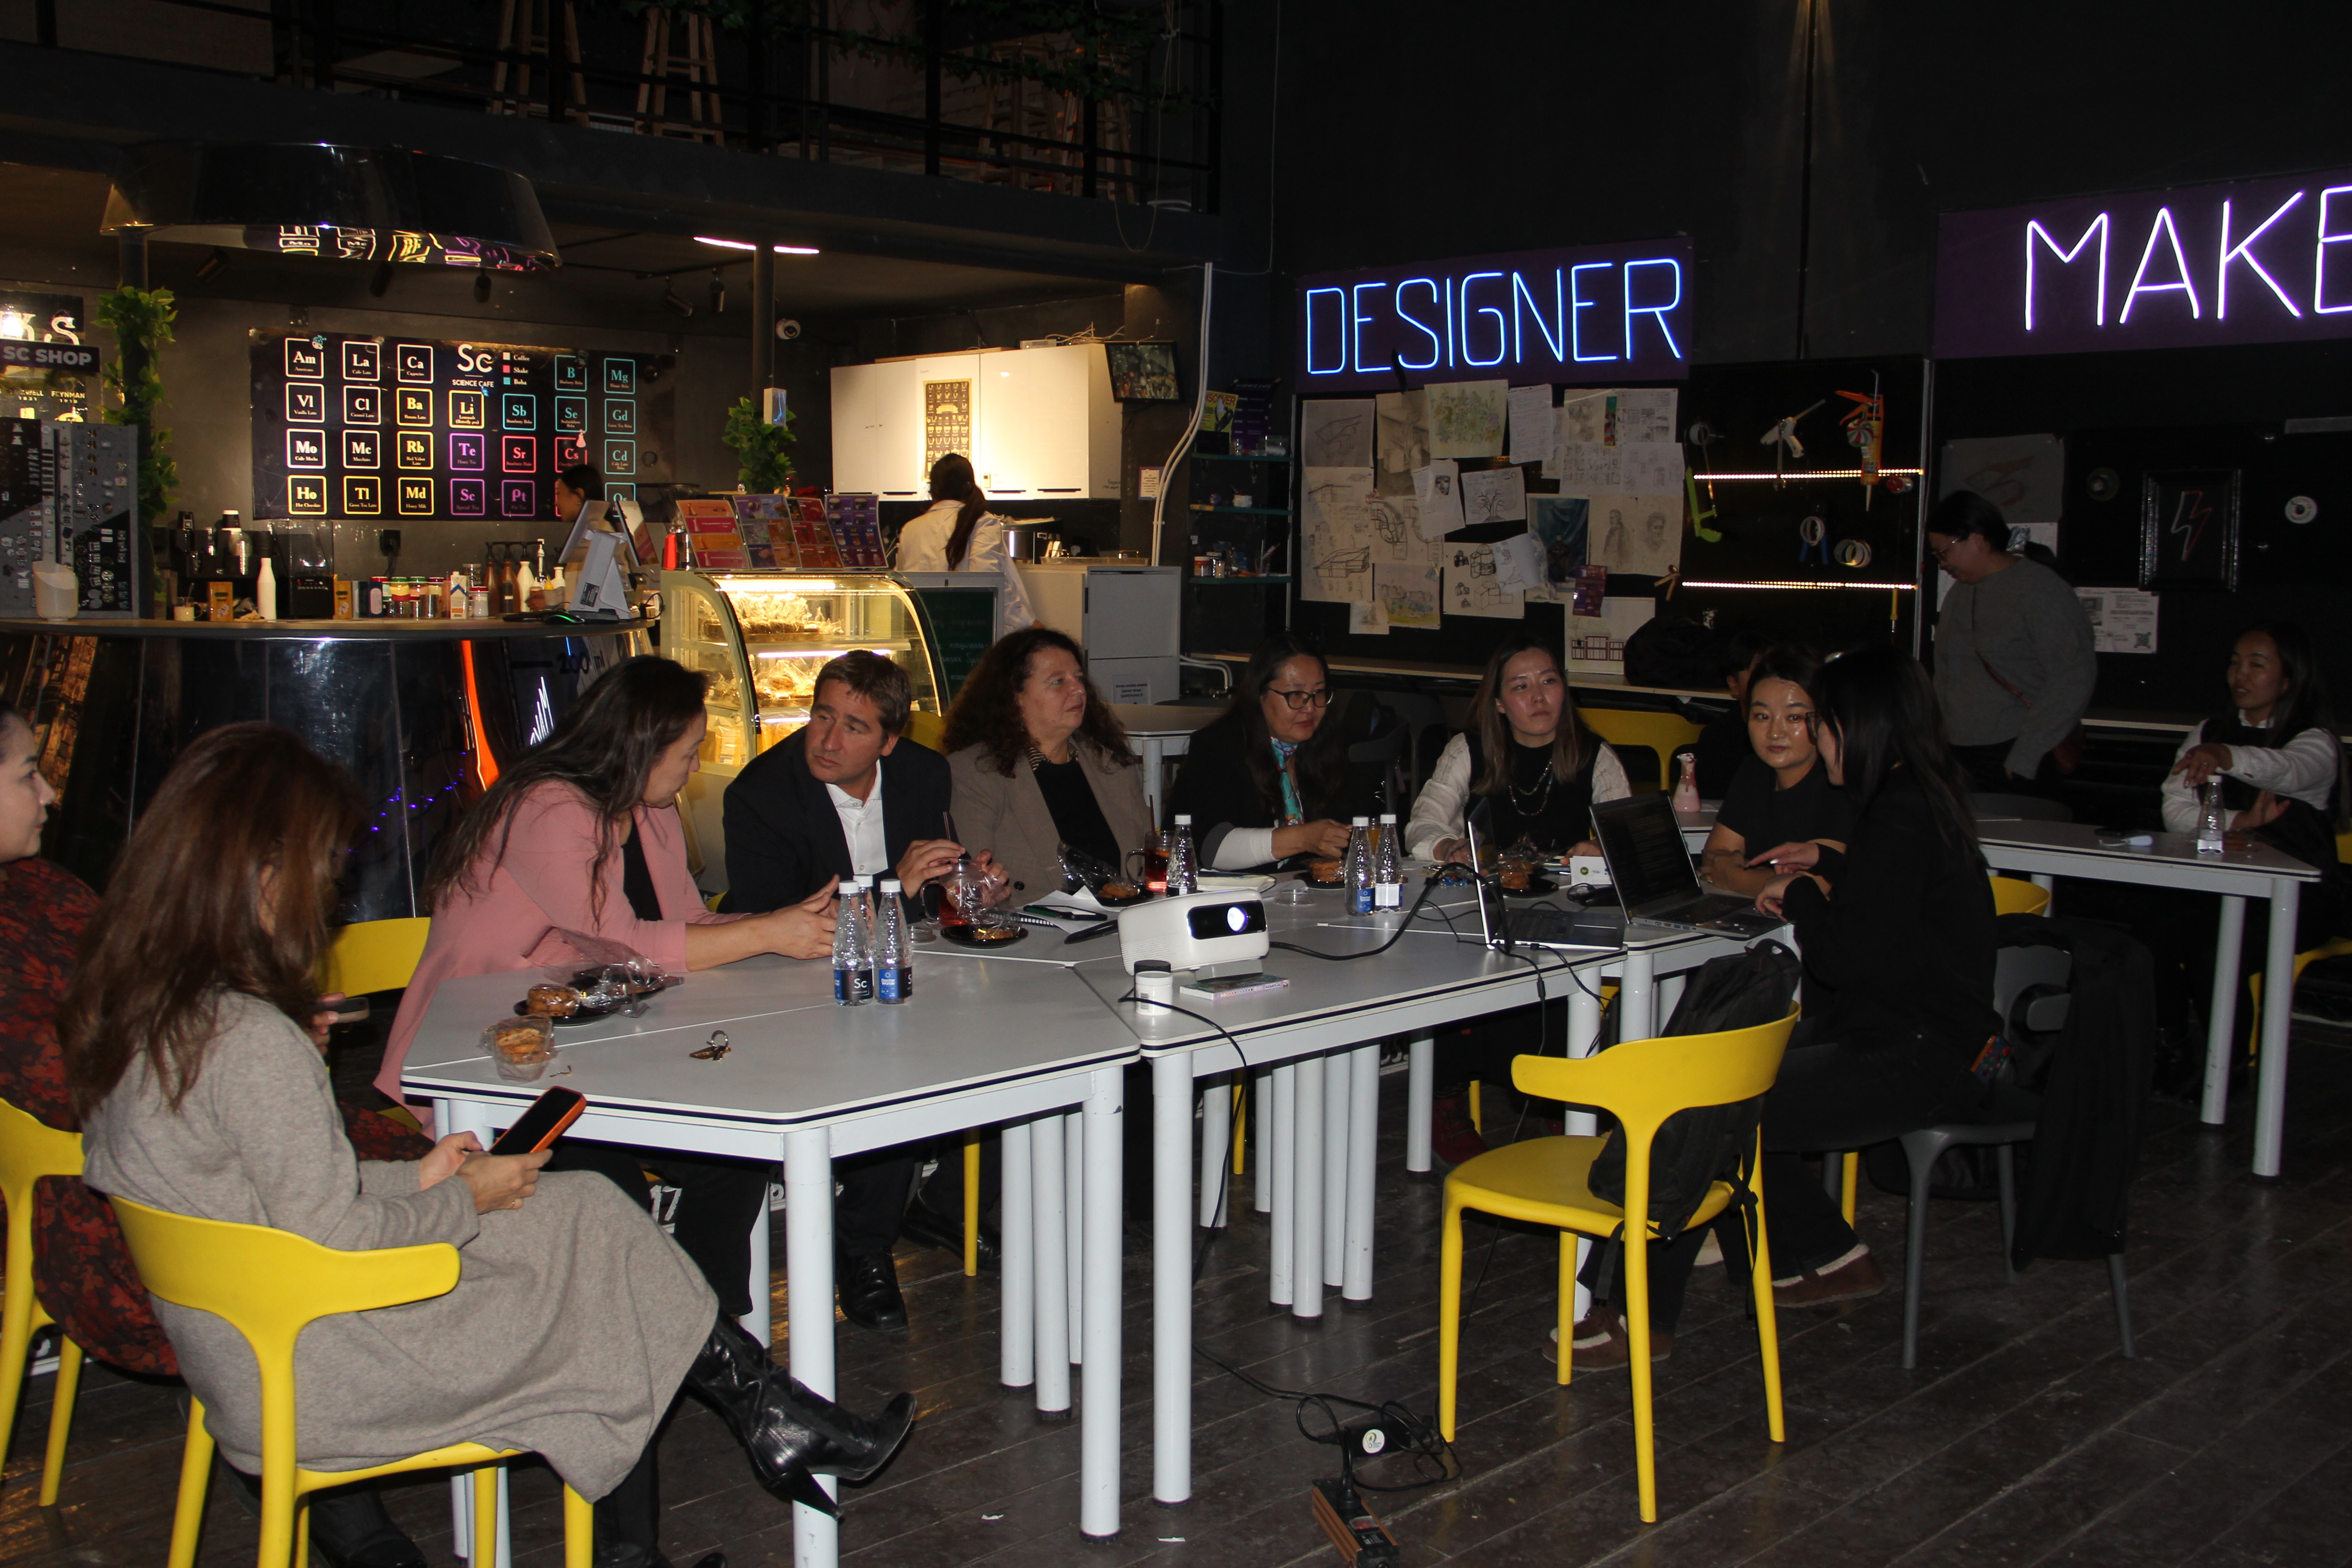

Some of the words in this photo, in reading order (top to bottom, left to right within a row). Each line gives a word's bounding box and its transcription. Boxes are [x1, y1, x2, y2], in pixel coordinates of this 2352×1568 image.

[2025, 186, 2352, 331] MAKE
[1307, 258, 1682, 374] DESIGNER
[4, 346, 30, 361] SC
[35, 348, 92, 366] SHOP
[293, 351, 316, 364] Am
[352, 354, 370, 367] La
[407, 356, 424, 369] Ca
[457, 343, 493, 373] Sc
[568, 367, 575, 378] B
[611, 370, 628, 383] Mg
[297, 394, 314, 407] Vl
[355, 398, 370, 411] Cl
[407, 397, 423, 410] Ba
[460, 401, 475, 415] Li
[512, 405, 527, 416] Sb
[564, 407, 578, 418] Se
[612, 410, 628, 421] Gd
[296, 440, 318, 454] Mo
[352, 441, 372, 454] Mc
[407, 441, 425, 453] Rb
[458, 443, 476, 456] Te
[513, 447, 526, 459] Sr
[564, 448, 579, 459] Cs
[612, 450, 627, 461] Cd
[296, 486, 317, 500] Ho
[355, 487, 370, 500] Tl
[406, 486, 426, 499] Md
[460, 488, 475, 501] Sc
[511, 489, 526, 502] Pt
[557, 652, 590, 675] 200
[854, 978, 867, 989] Sc
